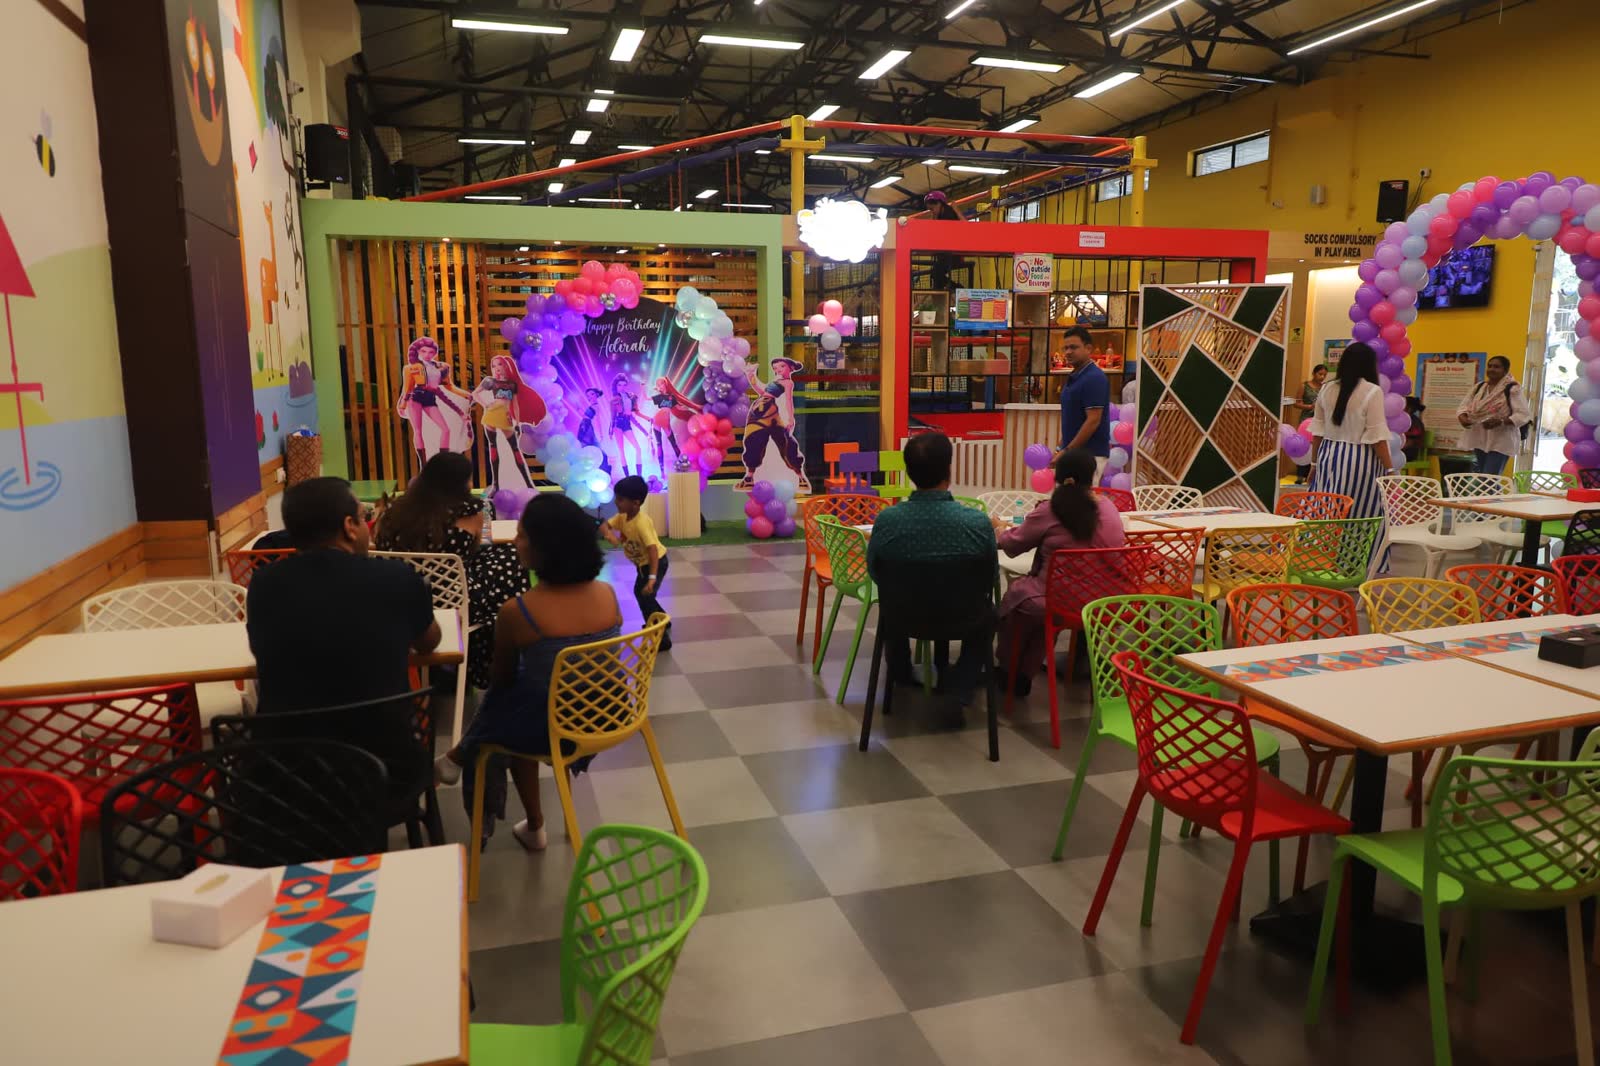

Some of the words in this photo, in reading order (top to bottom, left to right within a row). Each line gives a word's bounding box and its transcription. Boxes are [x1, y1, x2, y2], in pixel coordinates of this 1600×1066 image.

[1304, 233, 1328, 245] SOCKS
[1330, 235, 1376, 245] COMPULSORY
[1315, 247, 1321, 257] IN
[1325, 247, 1342, 257] PLAY
[1343, 247, 1361, 258] AREA
[1034, 258, 1044, 266] No
[1029, 280, 1050, 288] Beverage
[584, 320, 613, 335] Happy
[616, 318, 660, 334] Birthday
[599, 335, 649, 358] Adirah
